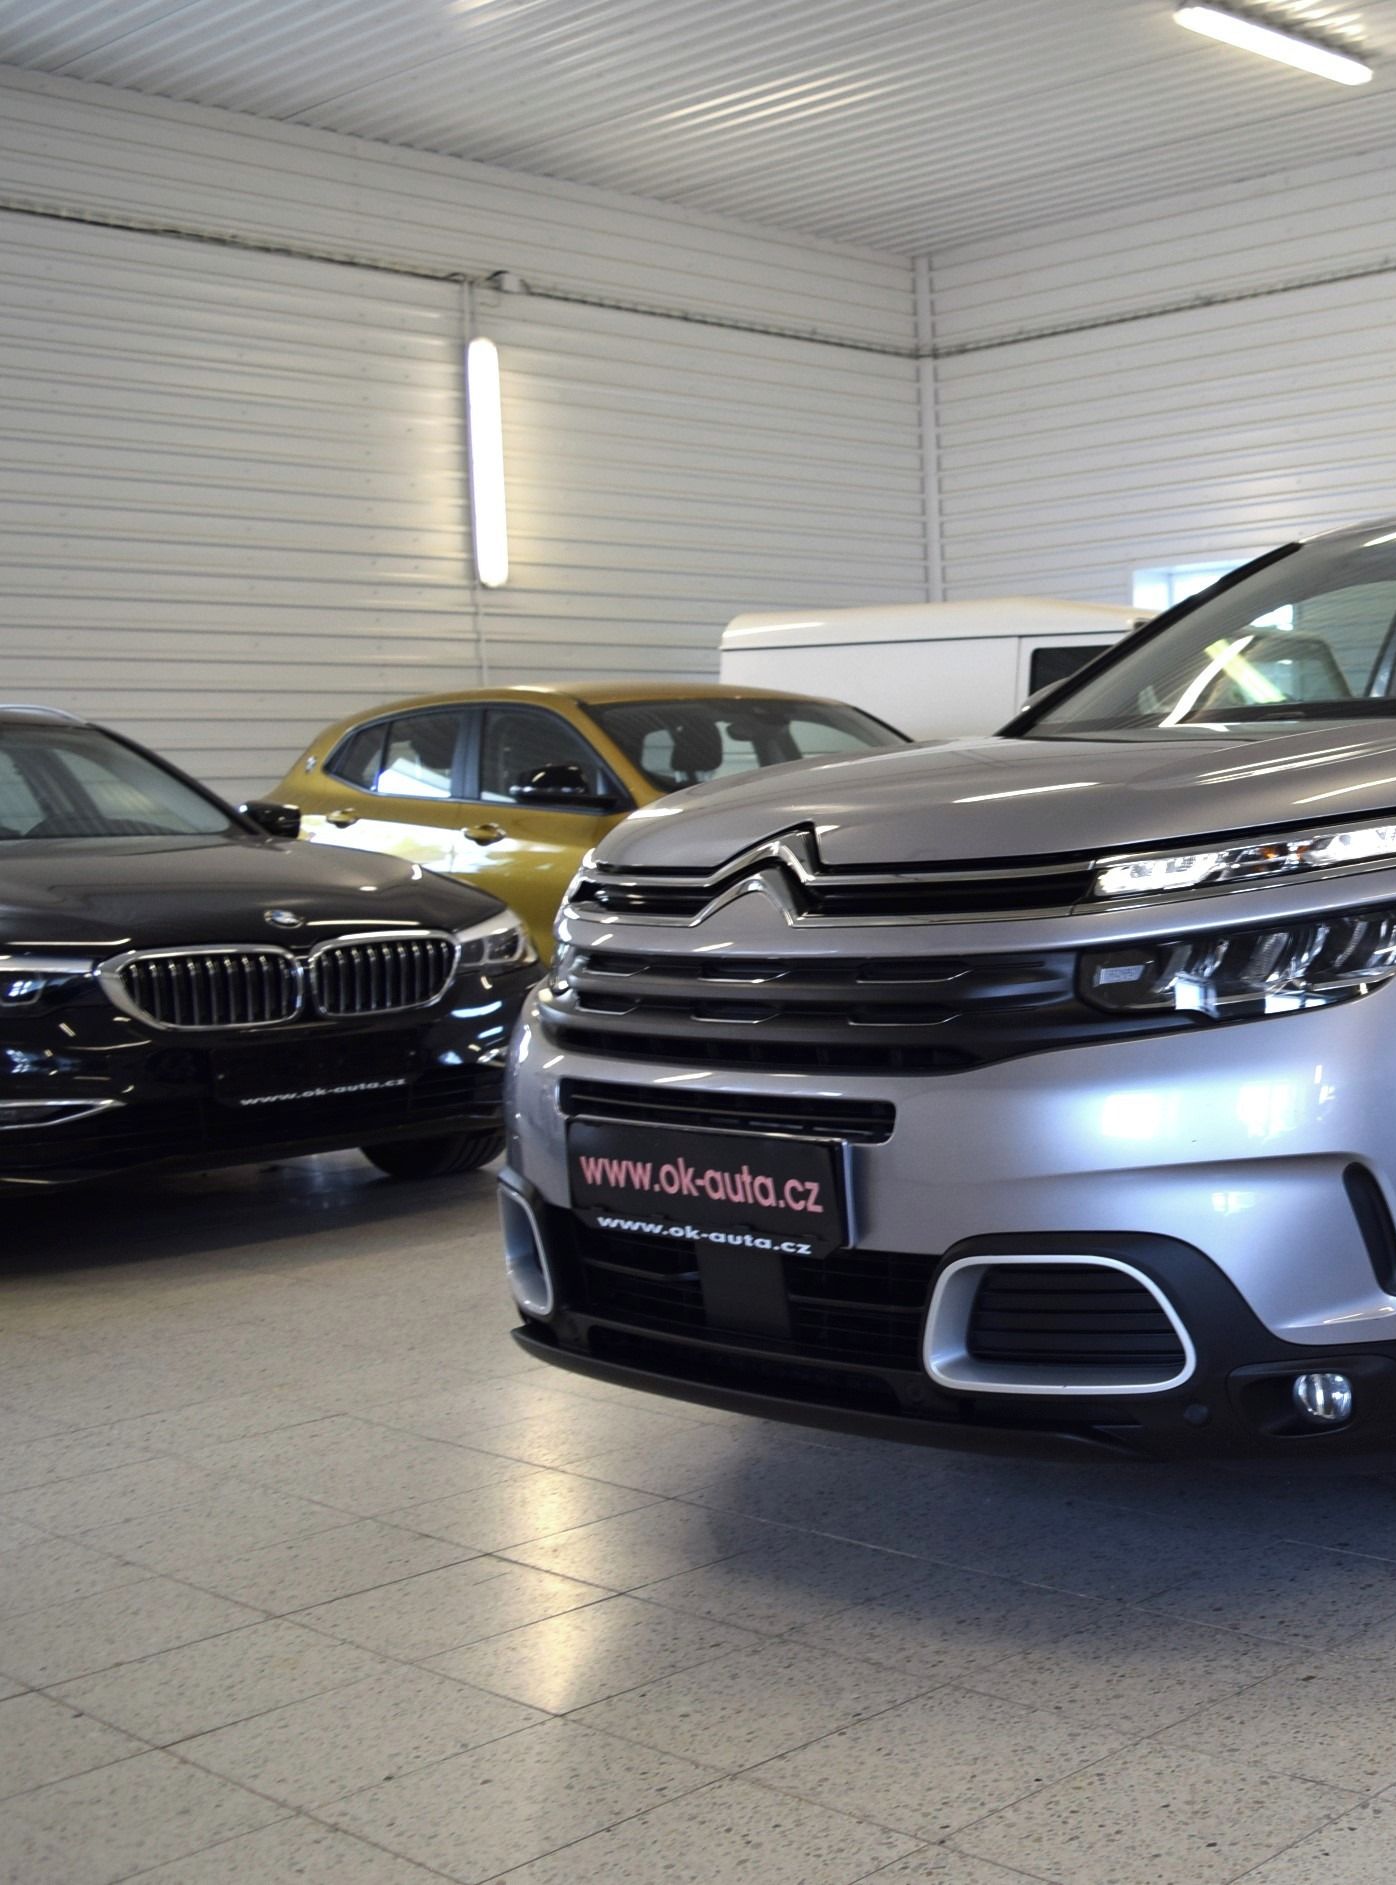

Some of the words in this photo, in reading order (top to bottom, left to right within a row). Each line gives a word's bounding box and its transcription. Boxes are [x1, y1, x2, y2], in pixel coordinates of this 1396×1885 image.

[239, 1078, 406, 1106] www.ok-auta.cz
[579, 1155, 824, 1213] www.ok-auta.cz
[597, 1215, 812, 1255] www.ok-auta.cz
